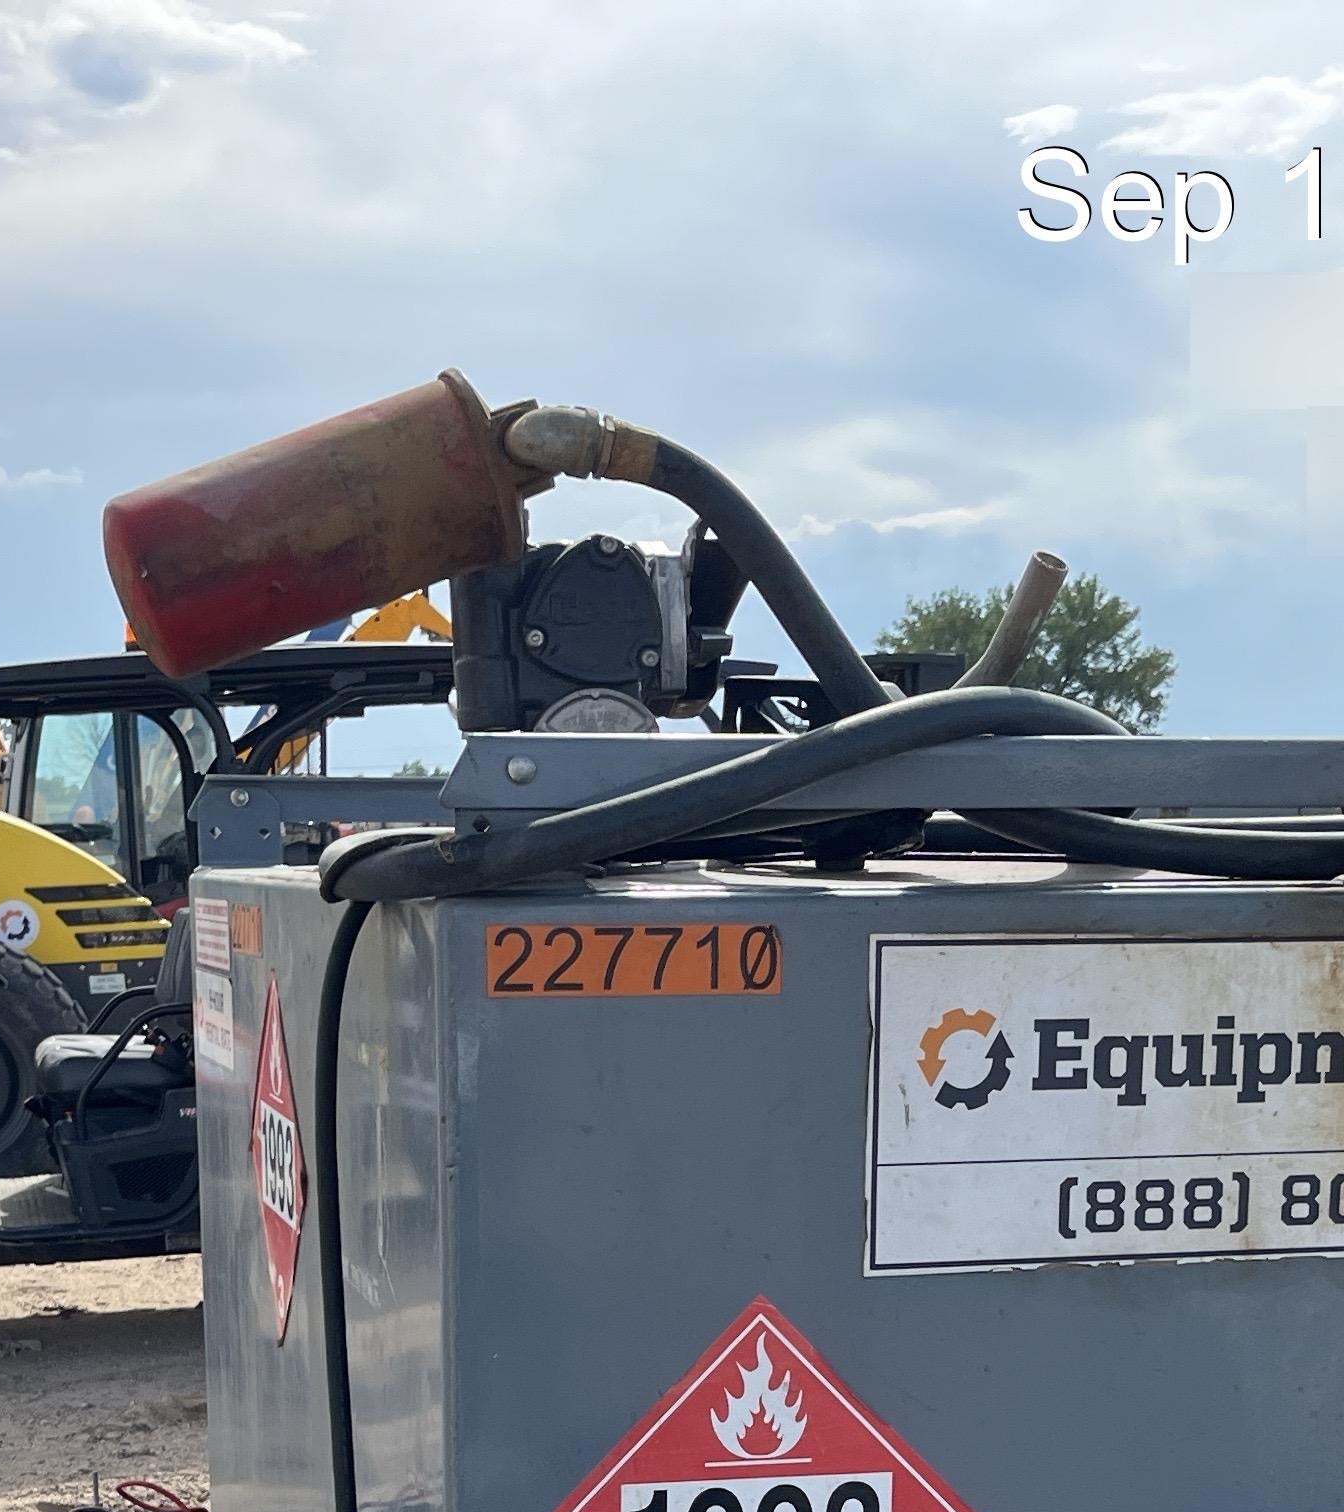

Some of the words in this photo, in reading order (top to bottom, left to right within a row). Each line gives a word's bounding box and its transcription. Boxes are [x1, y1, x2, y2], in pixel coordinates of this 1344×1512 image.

[493, 925, 778, 992] 227710
[262, 1107, 294, 1221] 1993
[1058, 1171, 1250, 1239] (888)
